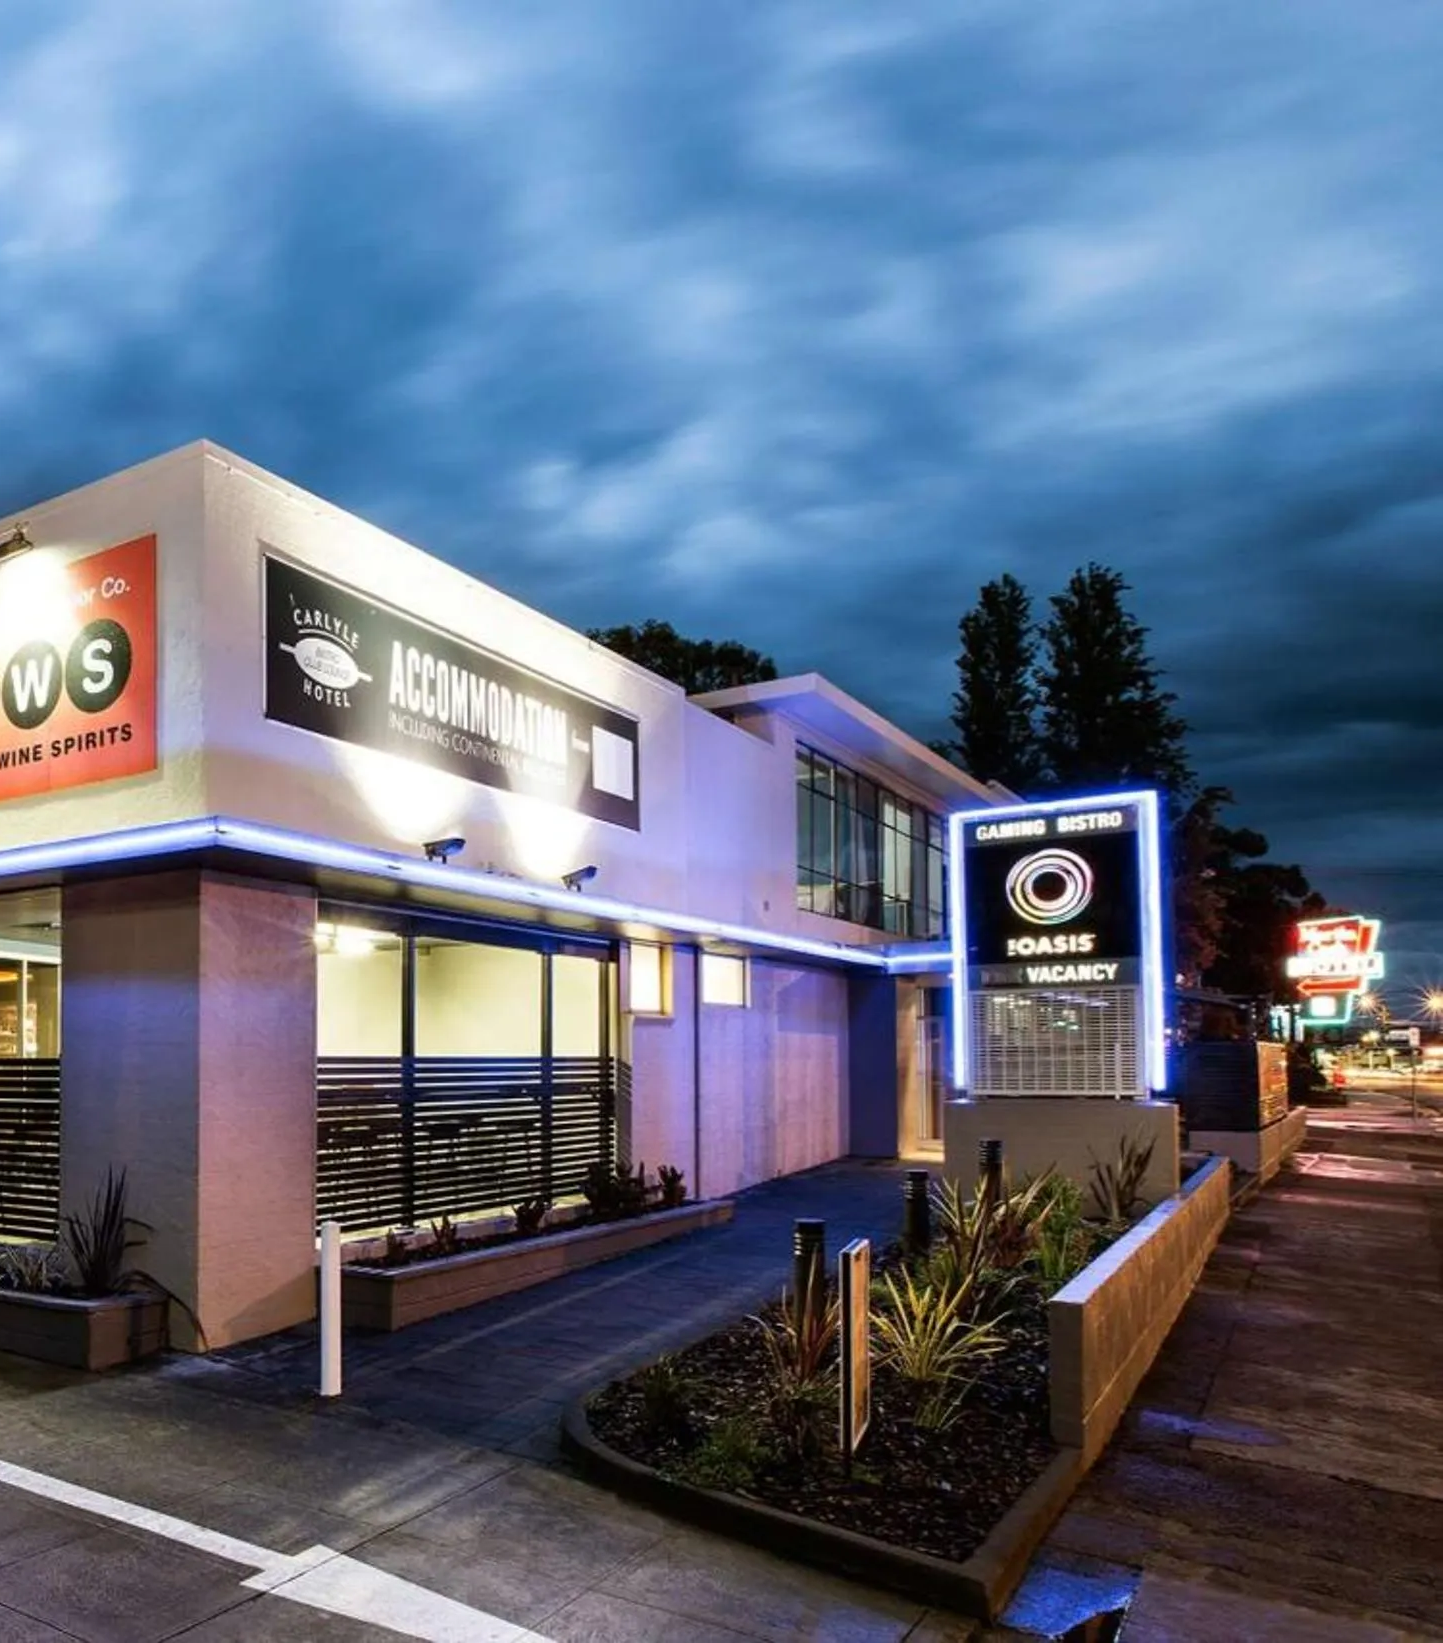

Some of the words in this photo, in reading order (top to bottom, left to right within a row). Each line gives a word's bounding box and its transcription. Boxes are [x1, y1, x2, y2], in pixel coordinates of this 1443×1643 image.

[101, 576, 131, 598] Co.
[293, 608, 359, 650] CARLYLE
[303, 678, 351, 708] HOTEL
[389, 640, 568, 766] ACCOMMODATION
[51, 722, 133, 758] SPIRITS
[388, 710, 450, 748] INCLUDING
[976, 819, 1046, 841] GAMING
[1057, 811, 1122, 833] BISTRO
[1026, 963, 1119, 984] VACANCY
